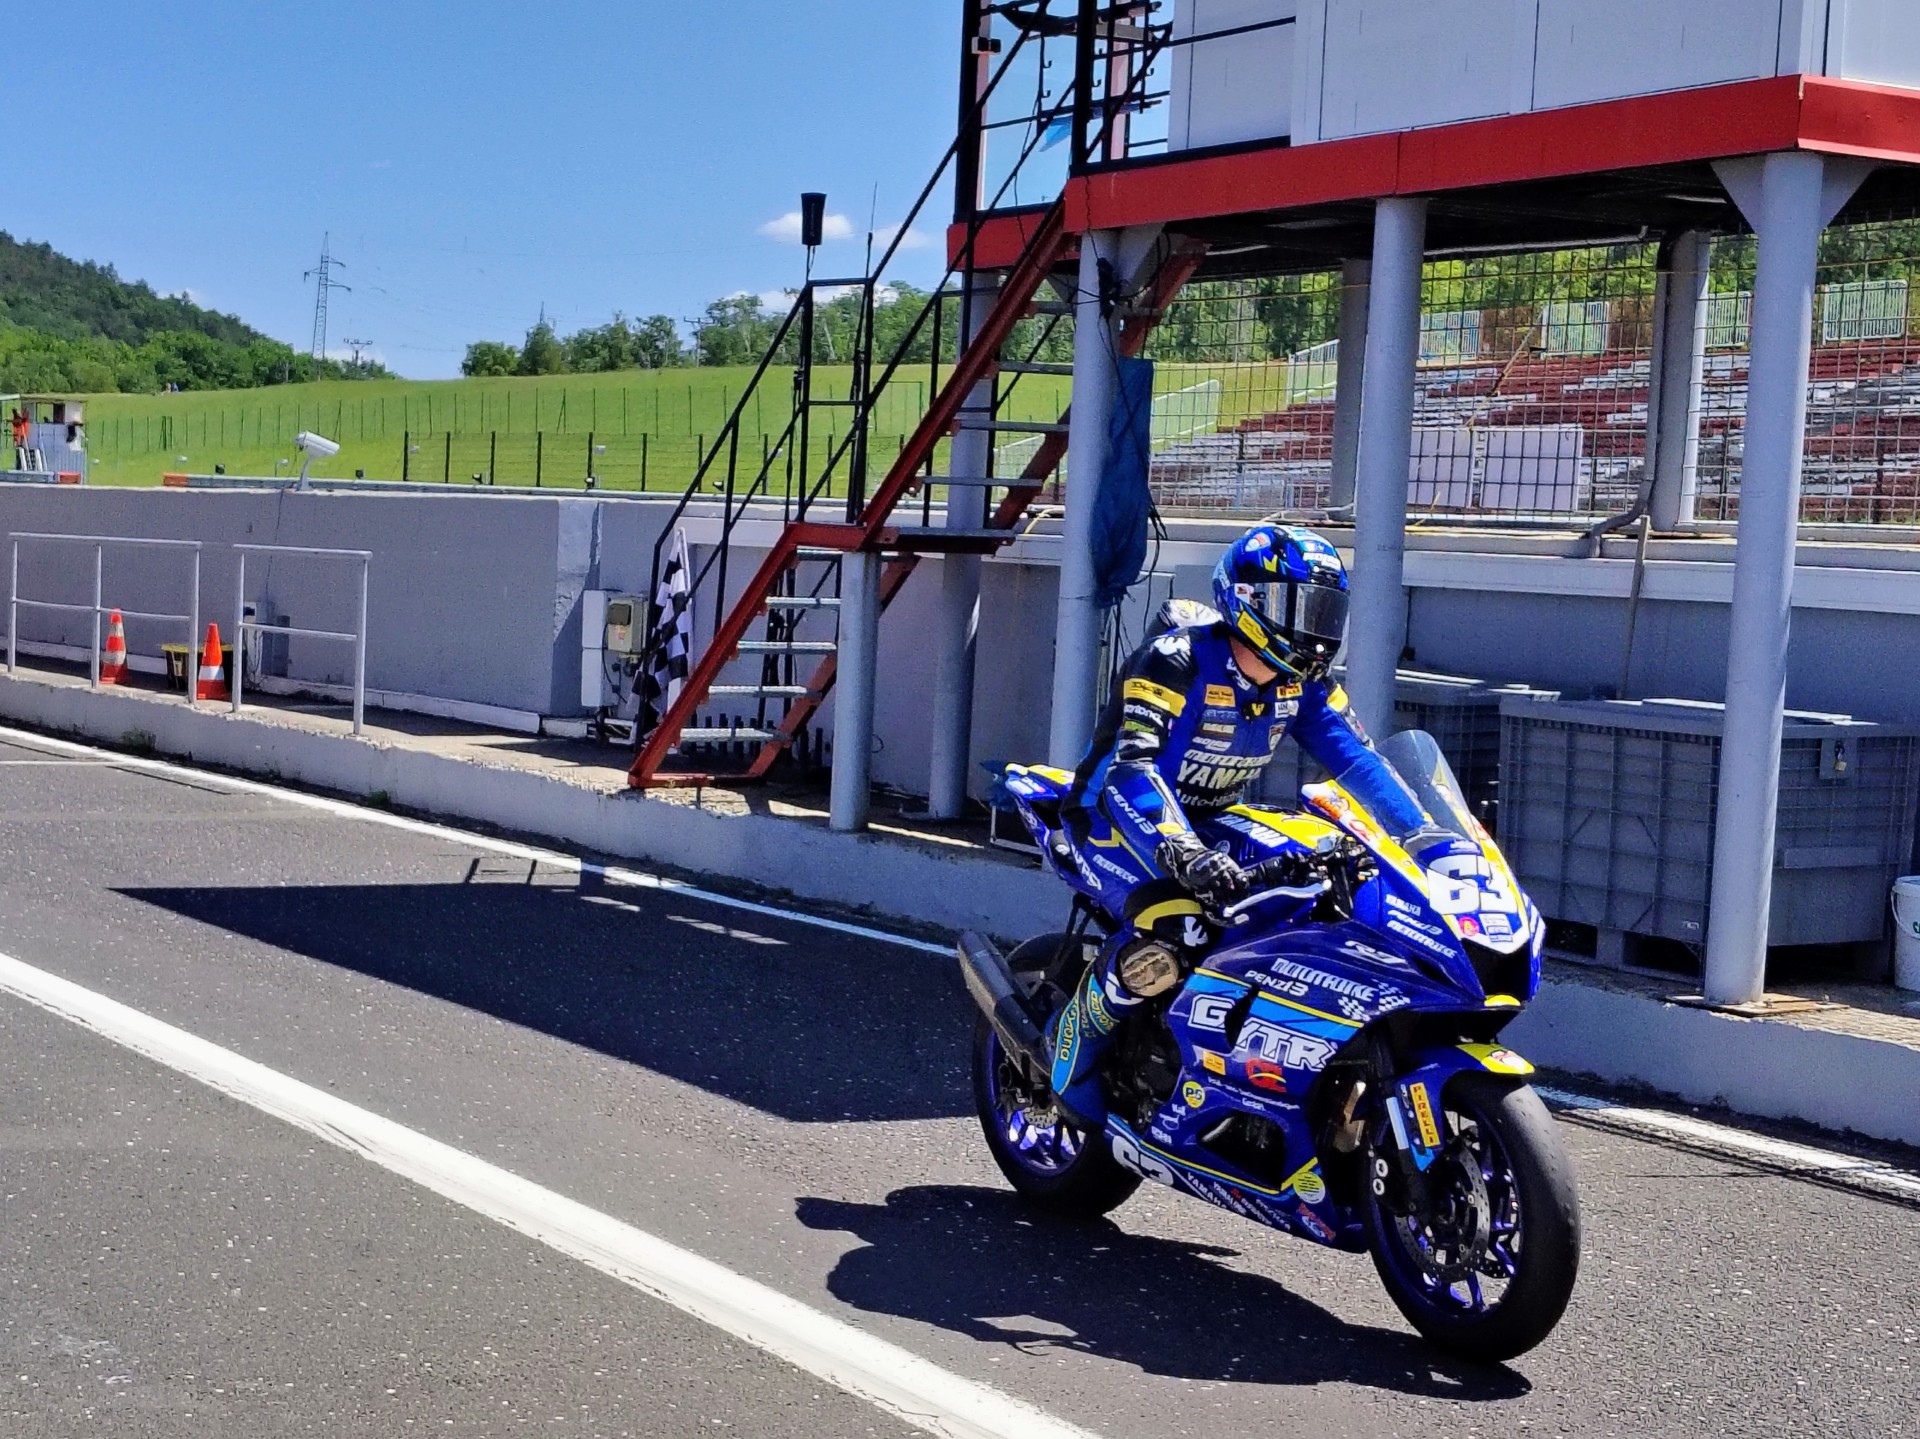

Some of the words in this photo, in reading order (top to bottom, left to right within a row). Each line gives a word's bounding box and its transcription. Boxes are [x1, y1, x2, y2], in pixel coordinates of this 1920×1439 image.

[1427, 854, 1520, 915] 63
[1244, 969, 1309, 997] PENZ13
[1412, 1085, 1434, 1144] PIRELLI
